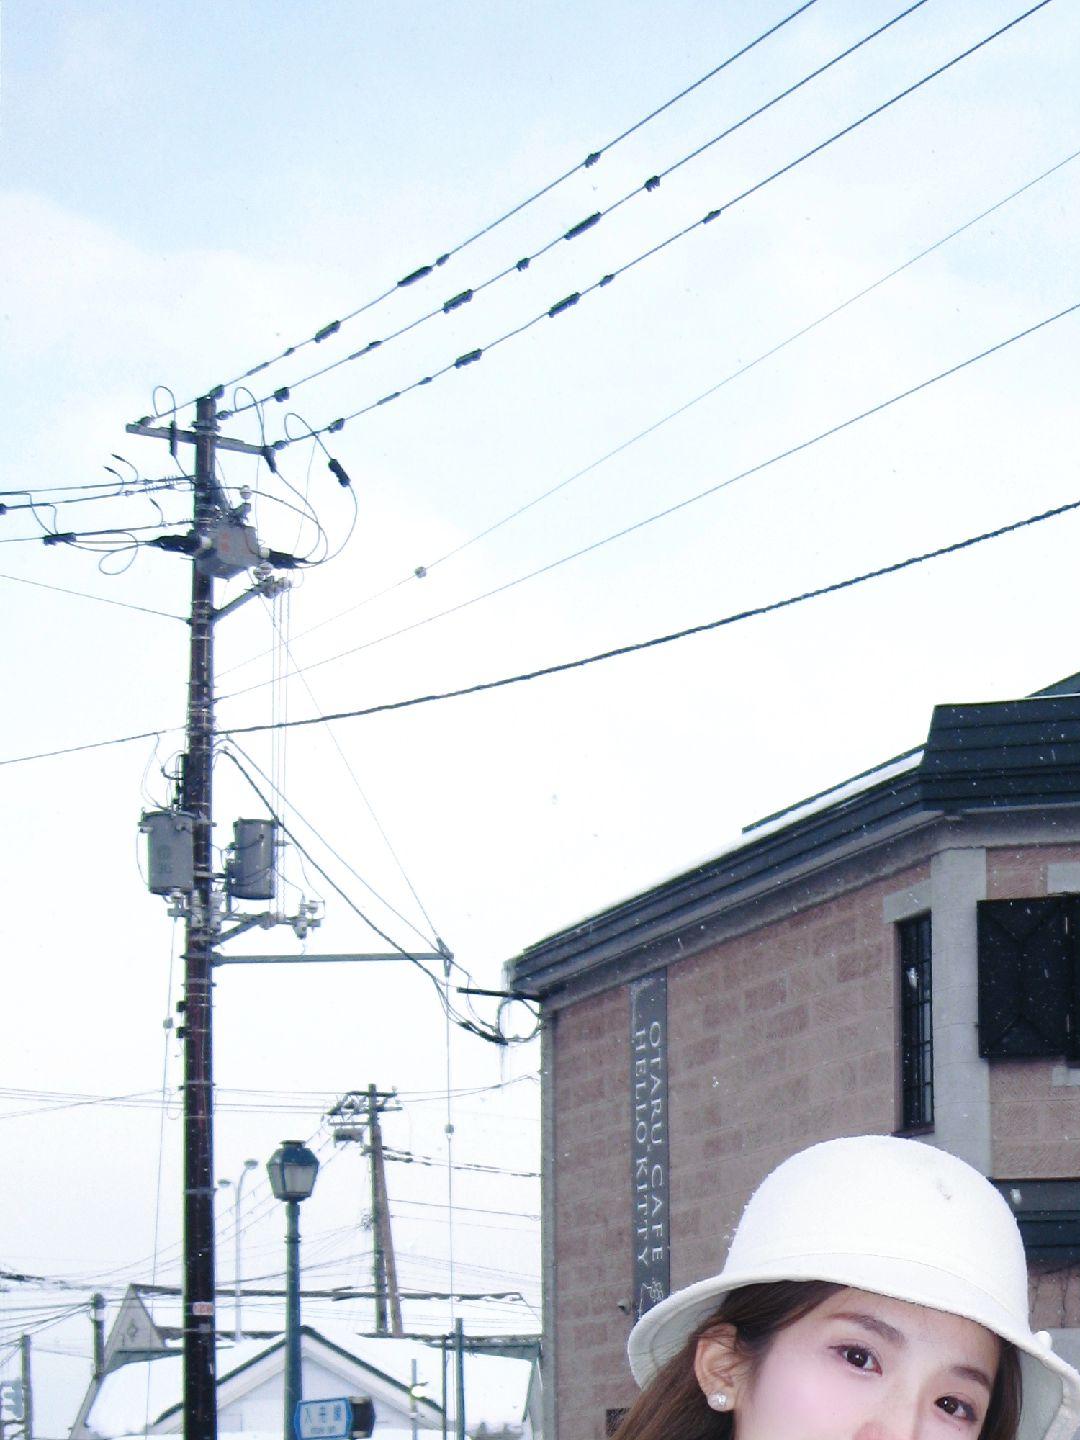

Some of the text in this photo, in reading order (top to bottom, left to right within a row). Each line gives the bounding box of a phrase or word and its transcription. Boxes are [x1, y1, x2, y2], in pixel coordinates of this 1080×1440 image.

[635, 1027, 649, 1266] HELLO KITTY
[649, 1021, 663, 1262] OTARU CAFE
